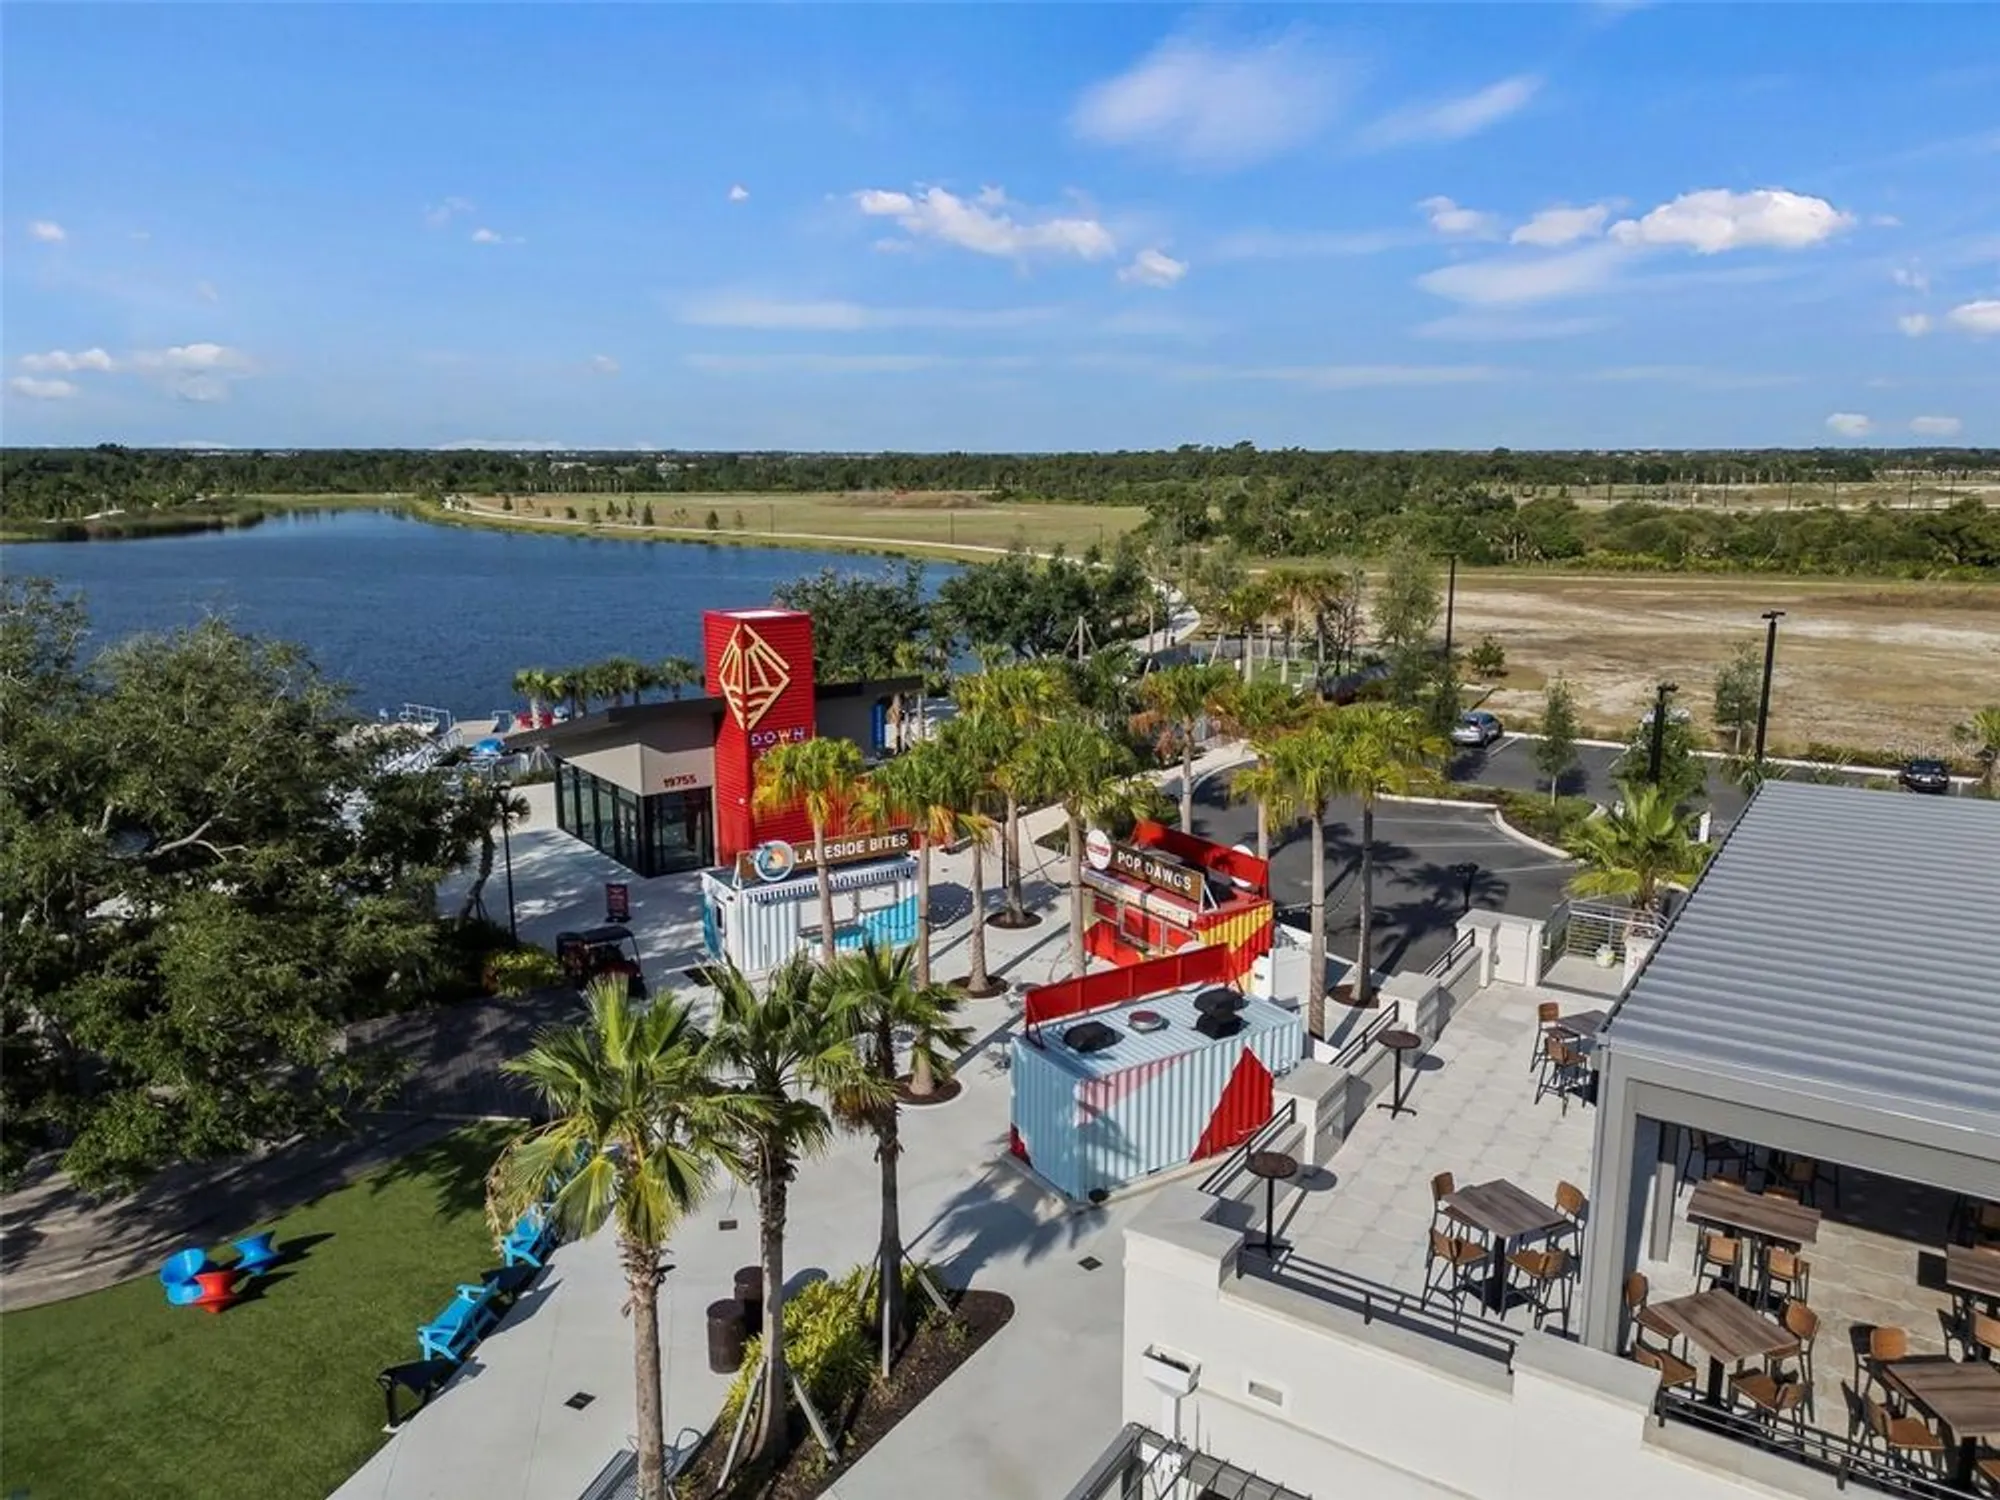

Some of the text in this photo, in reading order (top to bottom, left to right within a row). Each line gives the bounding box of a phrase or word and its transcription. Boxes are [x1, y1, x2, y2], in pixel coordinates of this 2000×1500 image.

[750, 726, 804, 746] DOWN
[663, 774, 697, 788] 19755
[795, 833, 909, 863] LAESIDE BITES
[1117, 850, 1141, 871] POP
[1145, 861, 1192, 892] DAWGS
